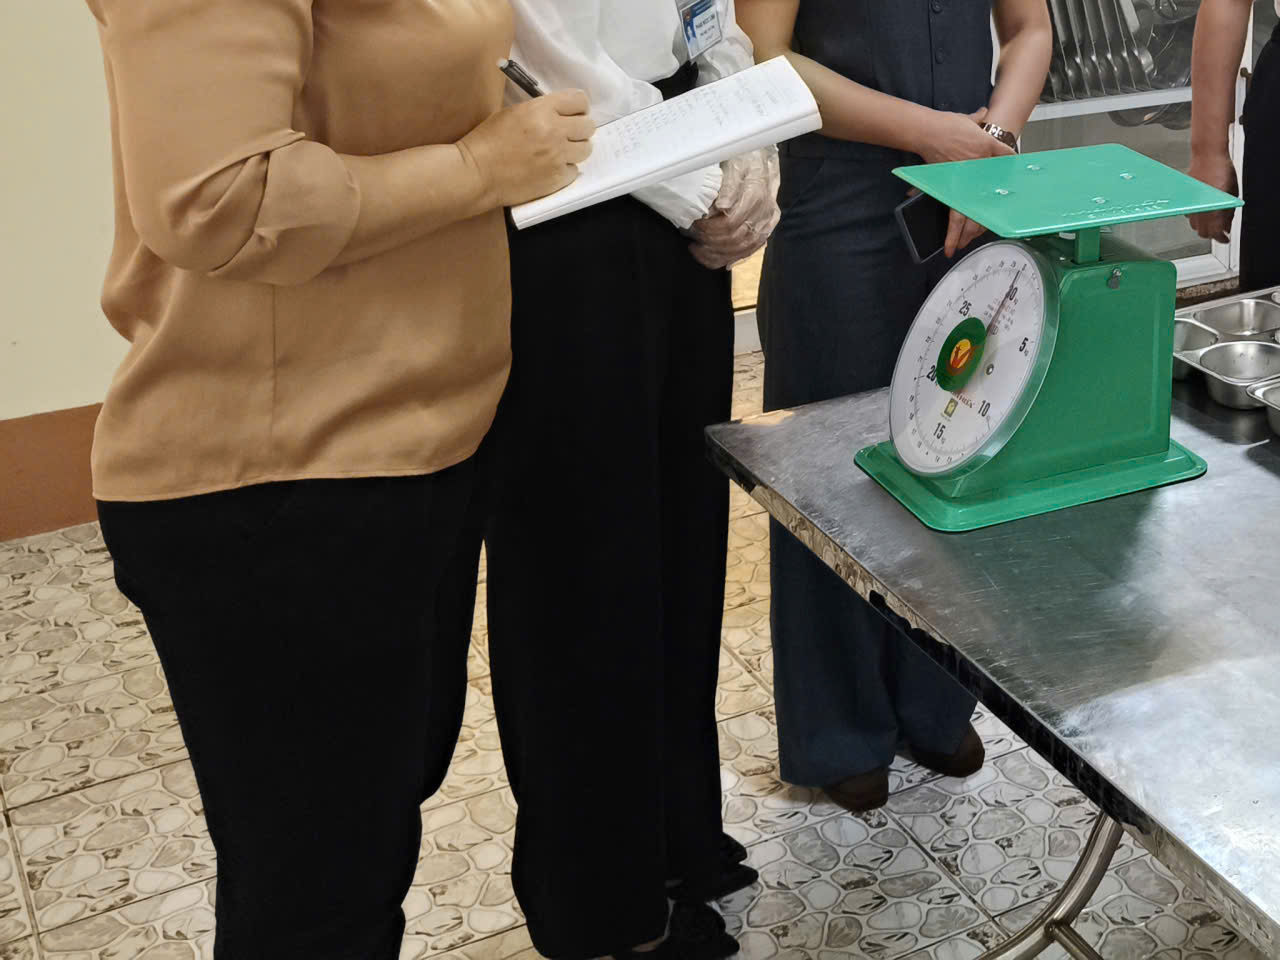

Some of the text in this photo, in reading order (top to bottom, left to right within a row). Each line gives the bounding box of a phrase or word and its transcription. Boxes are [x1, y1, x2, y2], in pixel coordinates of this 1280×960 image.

[958, 300, 972, 317] 25
[1018, 337, 1029, 352] 5
[927, 365, 937, 382] 20
[977, 399, 991, 417] 10
[933, 422, 946, 440] 15
